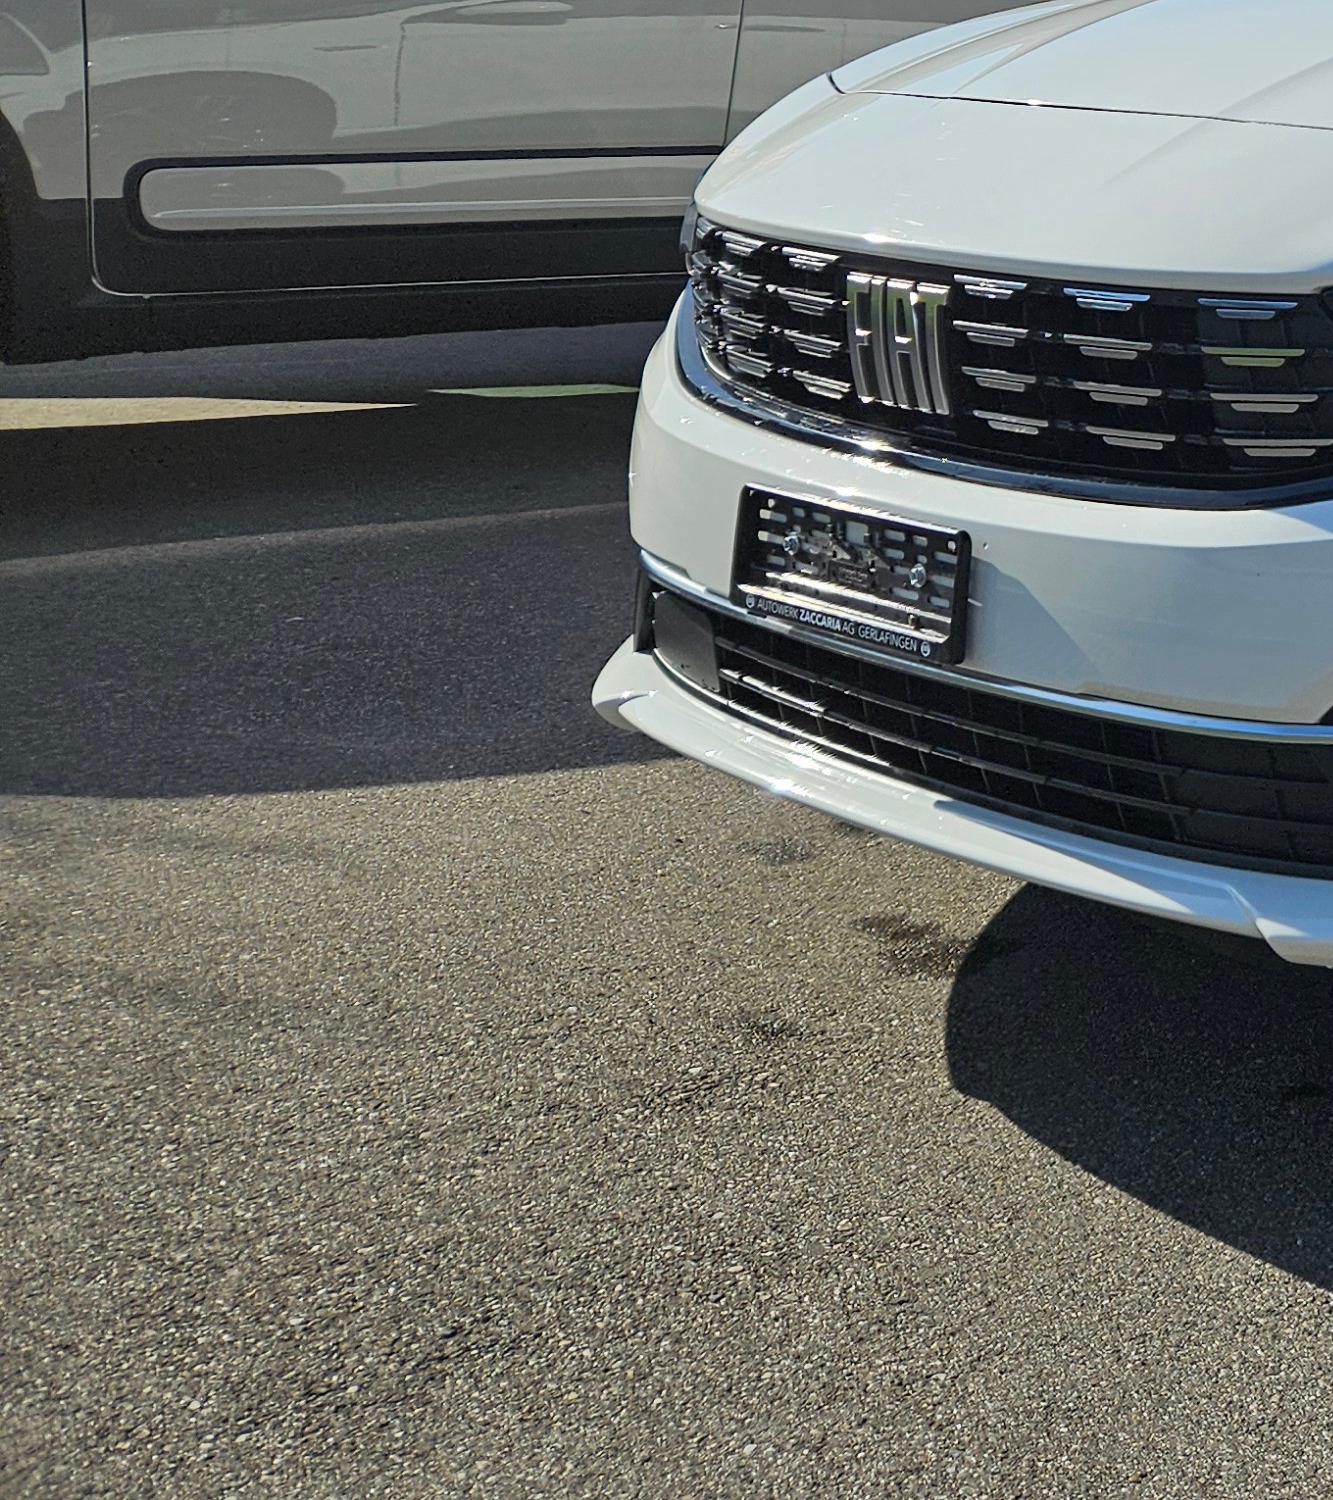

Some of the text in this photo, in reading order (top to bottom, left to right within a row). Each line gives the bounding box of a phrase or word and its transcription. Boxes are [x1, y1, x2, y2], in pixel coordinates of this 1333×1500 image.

[846, 271, 951, 415] FIAT
[757, 598, 799, 619] AUTOWERK
[799, 608, 841, 632] ZACCARIA
[842, 621, 855, 635] AG
[858, 626, 917, 651] GERLAFINGEN
